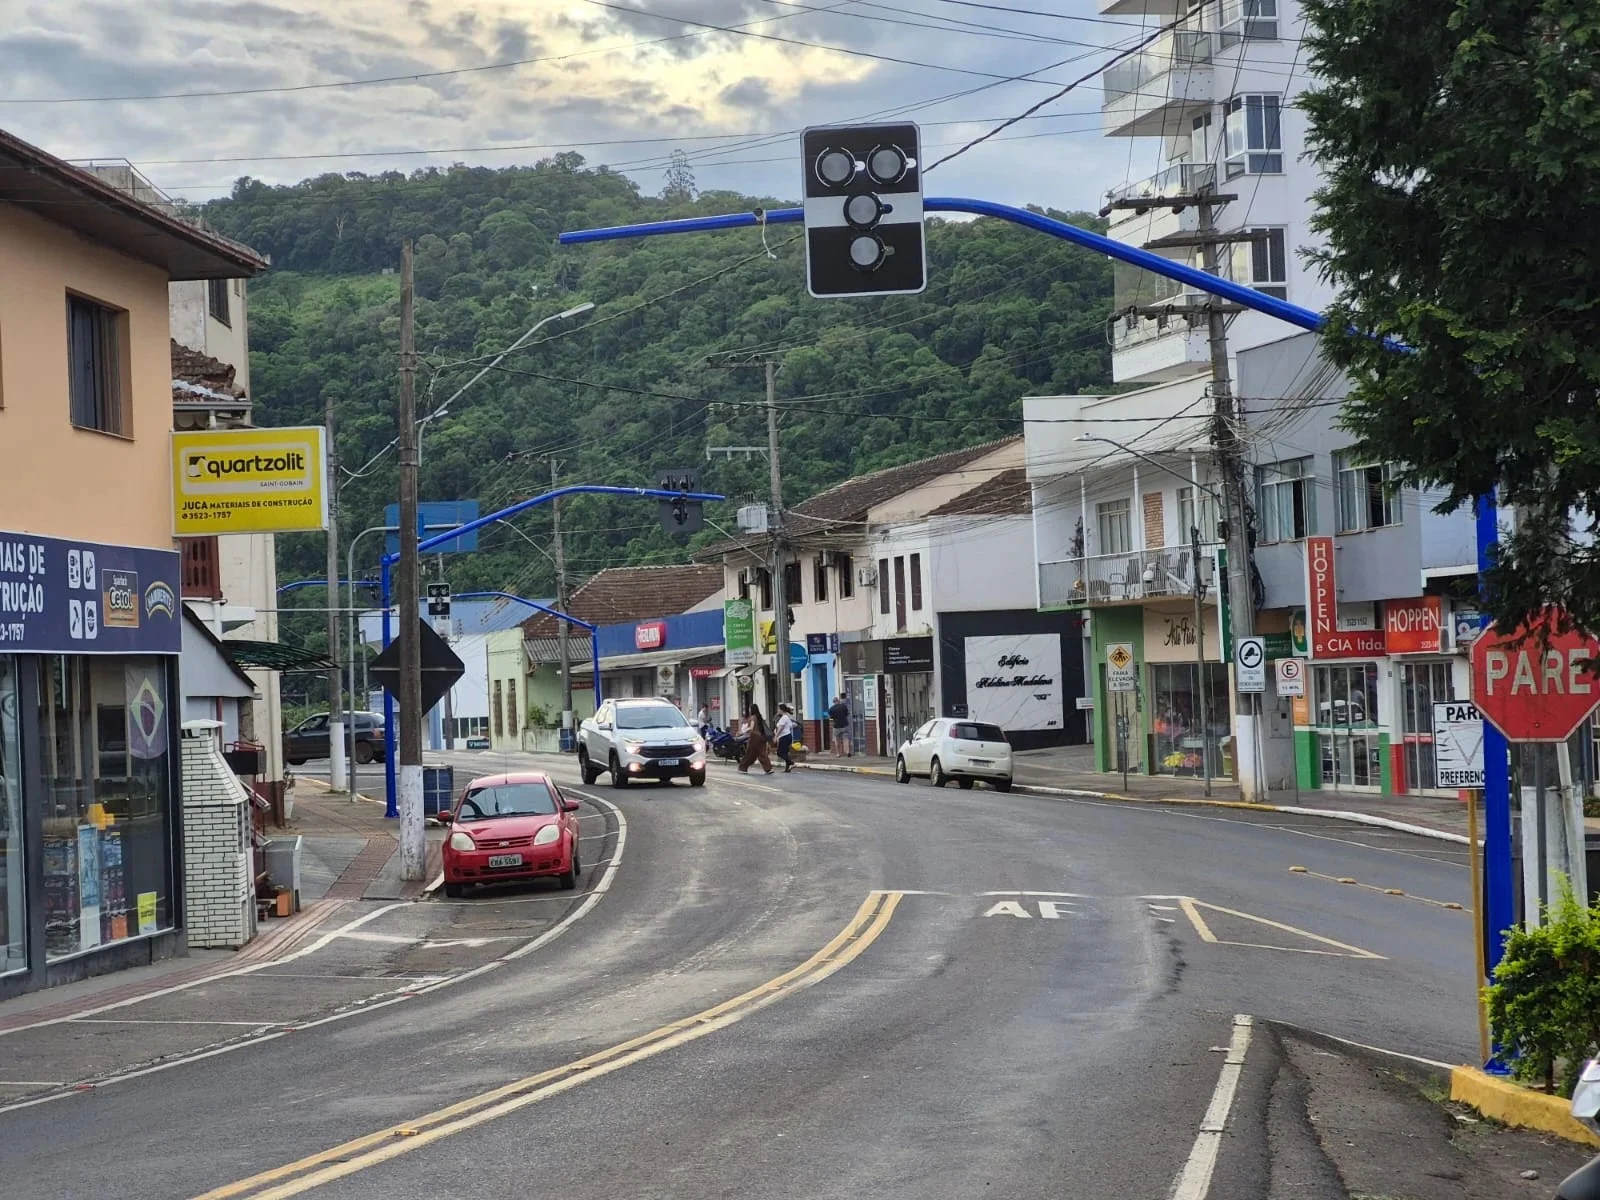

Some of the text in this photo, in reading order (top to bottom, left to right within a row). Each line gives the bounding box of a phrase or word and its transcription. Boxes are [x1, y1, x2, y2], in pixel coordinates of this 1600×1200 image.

[207, 453, 304, 479] quartzolit
[182, 501, 208, 510] JUCA
[210, 501, 250, 509] MATERIAIS
[262, 498, 312, 507] CONSTRUÇÃO
[189, 511, 231, 520] 3523-1757
[28, 544, 45, 574] DE
[109, 586, 133, 609] Cetol
[1313, 543, 1330, 634] HOPPEN
[1388, 607, 1439, 632] HOPPEN
[1327, 638, 1353, 651] CIA
[1357, 638, 1384, 650] ltda.
[1286, 665, 1293, 675] E
[1486, 649, 1591, 696] PARE
